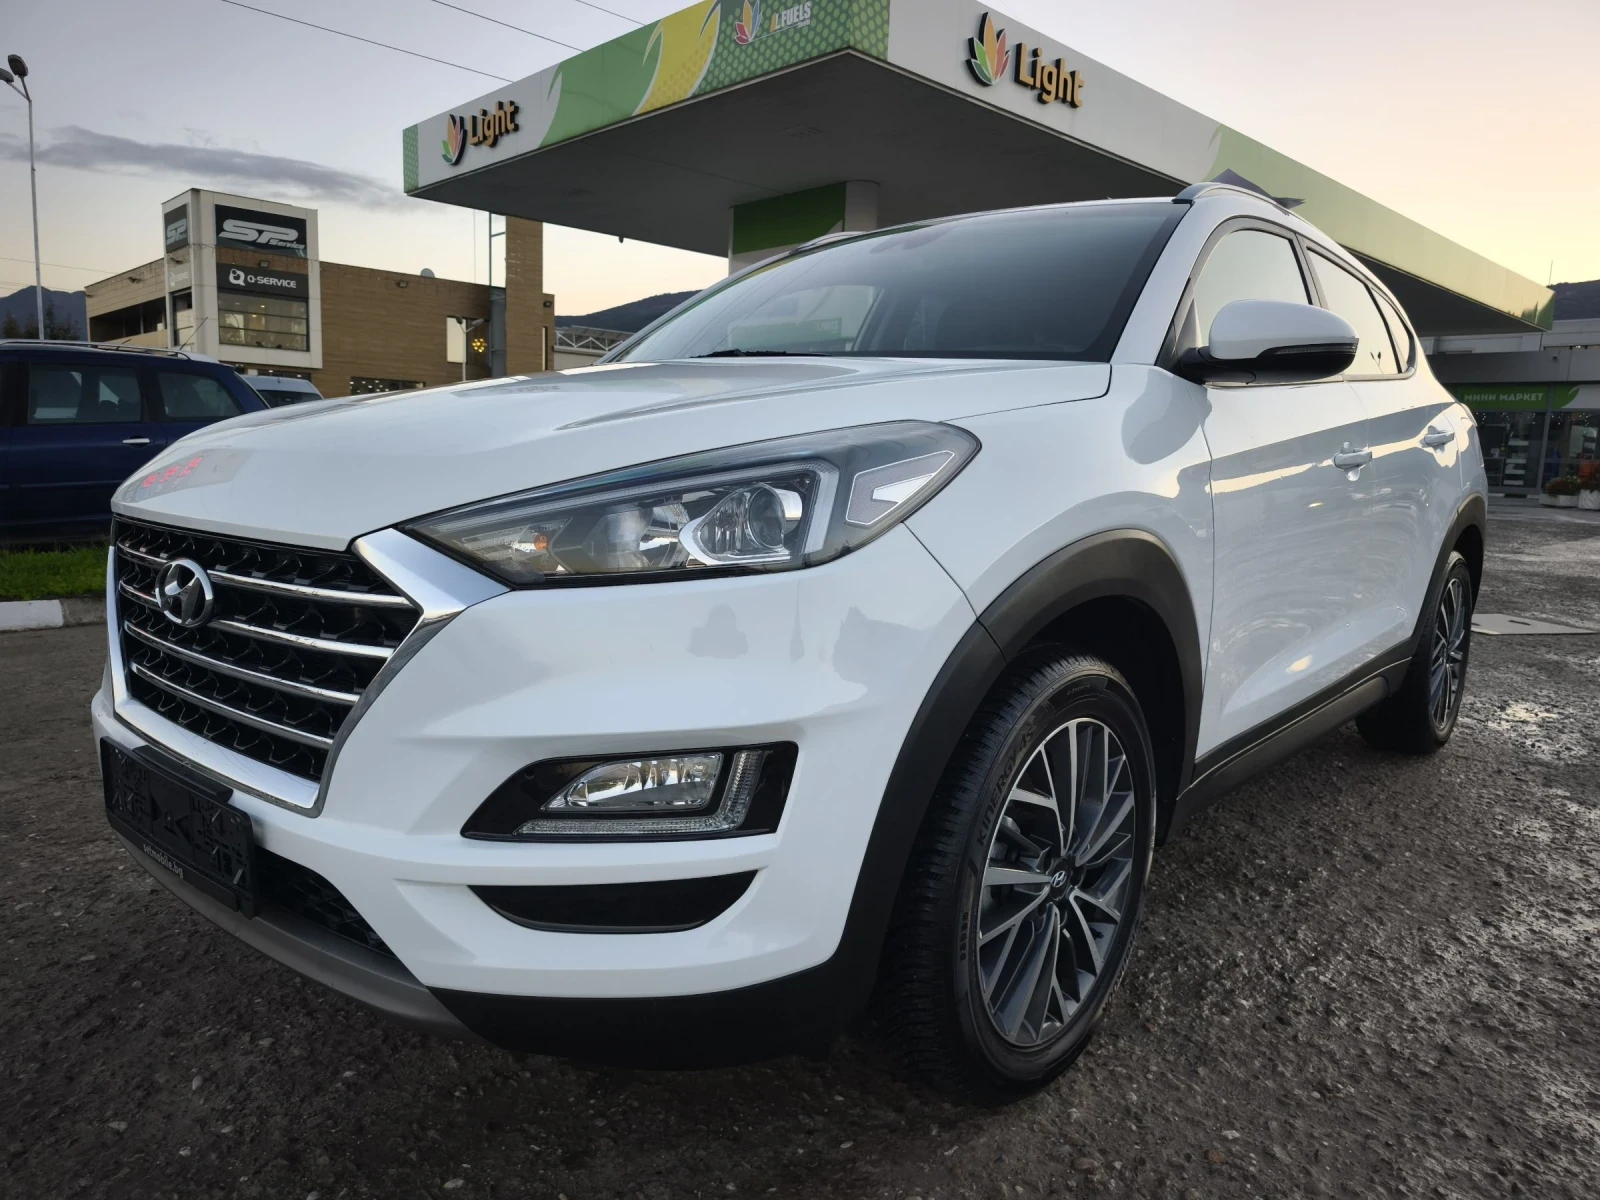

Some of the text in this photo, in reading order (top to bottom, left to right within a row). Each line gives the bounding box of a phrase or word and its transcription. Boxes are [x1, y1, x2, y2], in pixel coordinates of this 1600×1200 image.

[1014, 43, 1084, 108] Light
[468, 100, 519, 147] Light
[218, 219, 298, 244] SP
[268, 239, 305, 250] Service
[247, 275, 297, 288] Q-SERVICE
[1464, 393, 1544, 402] МИНИ МАРКЕТ
[977, 749, 1019, 847] KINERGY
